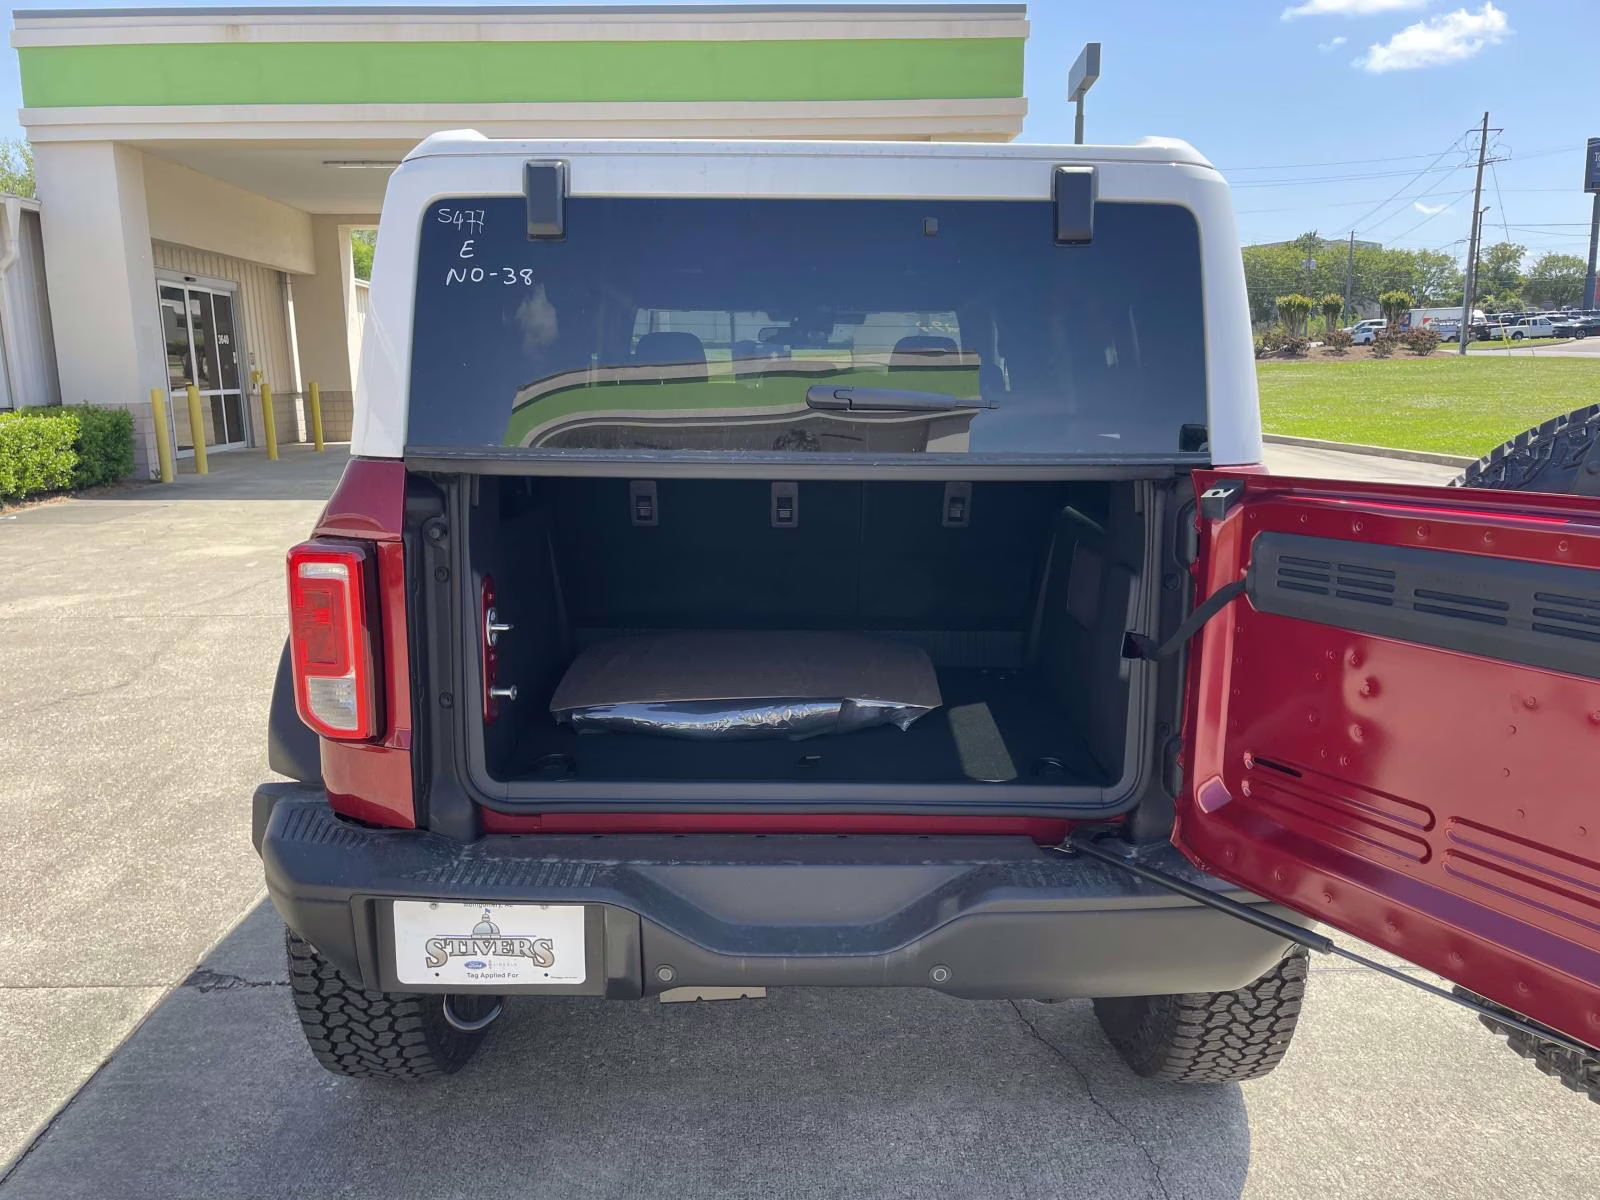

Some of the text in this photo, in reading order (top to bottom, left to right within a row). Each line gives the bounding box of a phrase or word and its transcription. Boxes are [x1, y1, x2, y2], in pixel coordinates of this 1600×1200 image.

[437, 208, 485, 235] S477
[459, 240, 475, 258] E
[425, 937, 555, 968] STIVERS
